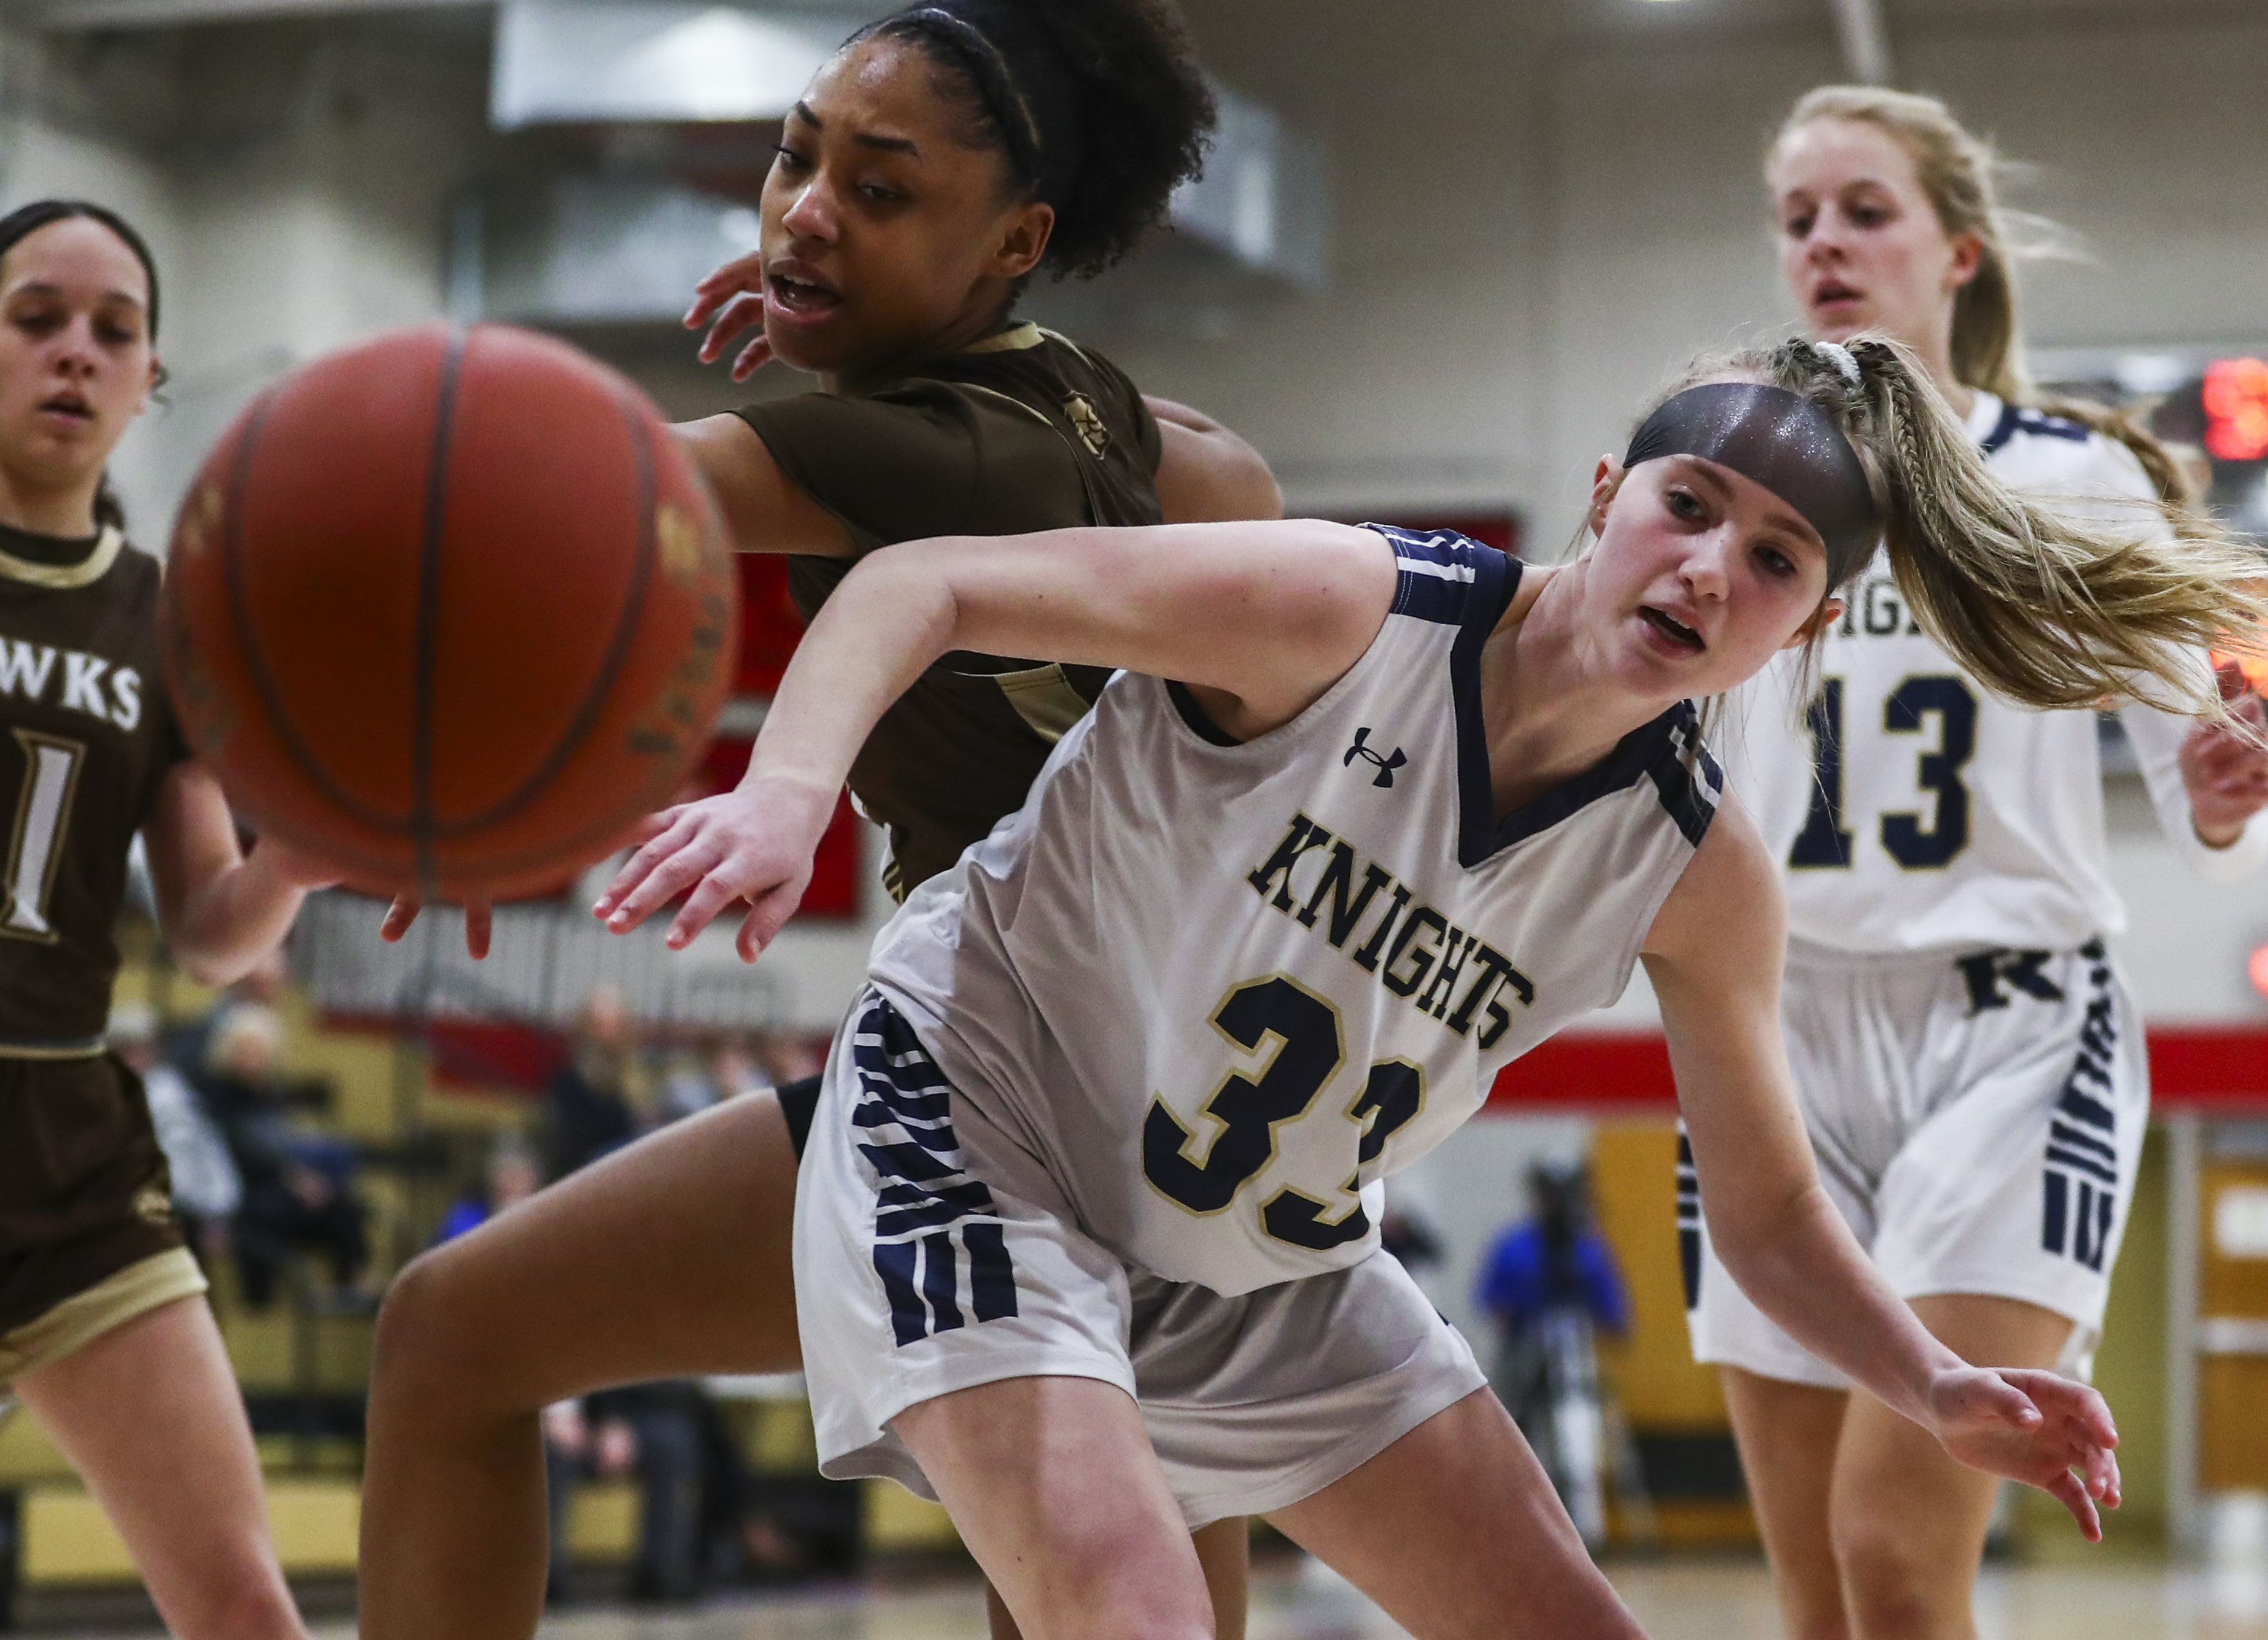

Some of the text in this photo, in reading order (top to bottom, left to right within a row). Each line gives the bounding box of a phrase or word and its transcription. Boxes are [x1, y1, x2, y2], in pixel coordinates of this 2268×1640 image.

[1787, 673, 1978, 872] 13
[1246, 810, 1534, 1051] KNIGHTS
[1141, 971, 1425, 1251] 33
